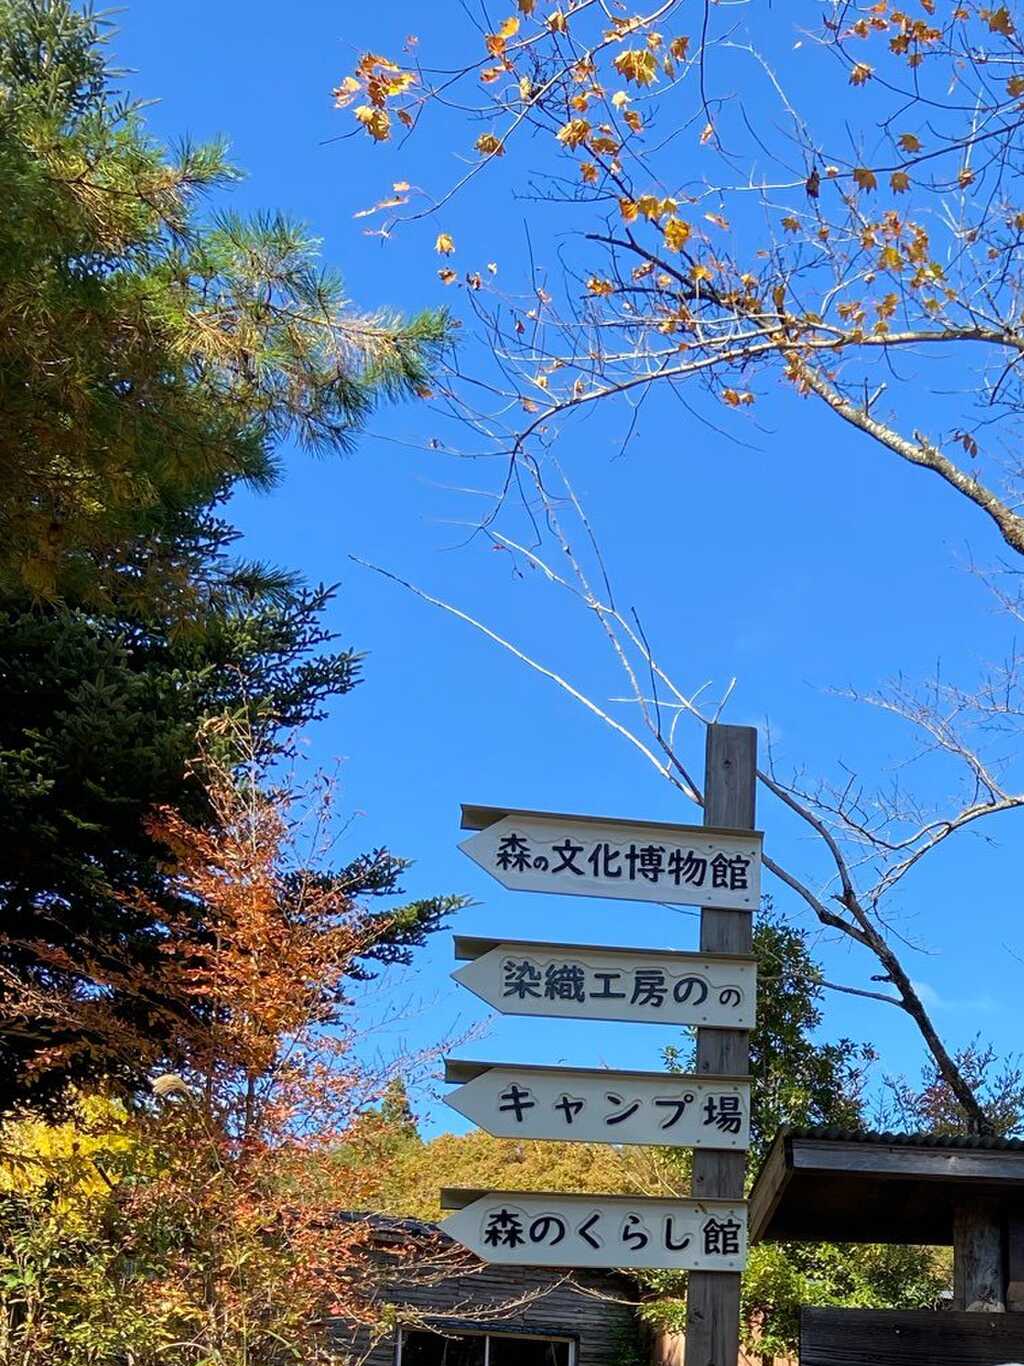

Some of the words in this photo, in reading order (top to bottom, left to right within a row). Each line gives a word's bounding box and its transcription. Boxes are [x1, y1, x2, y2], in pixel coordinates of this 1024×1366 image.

[496, 832, 750, 890] 森の文化博物館
[503, 960, 741, 1008] 染織工房のの
[499, 1085, 743, 1134] キャンプ場
[484, 1209, 742, 1256] 森のくらし館
